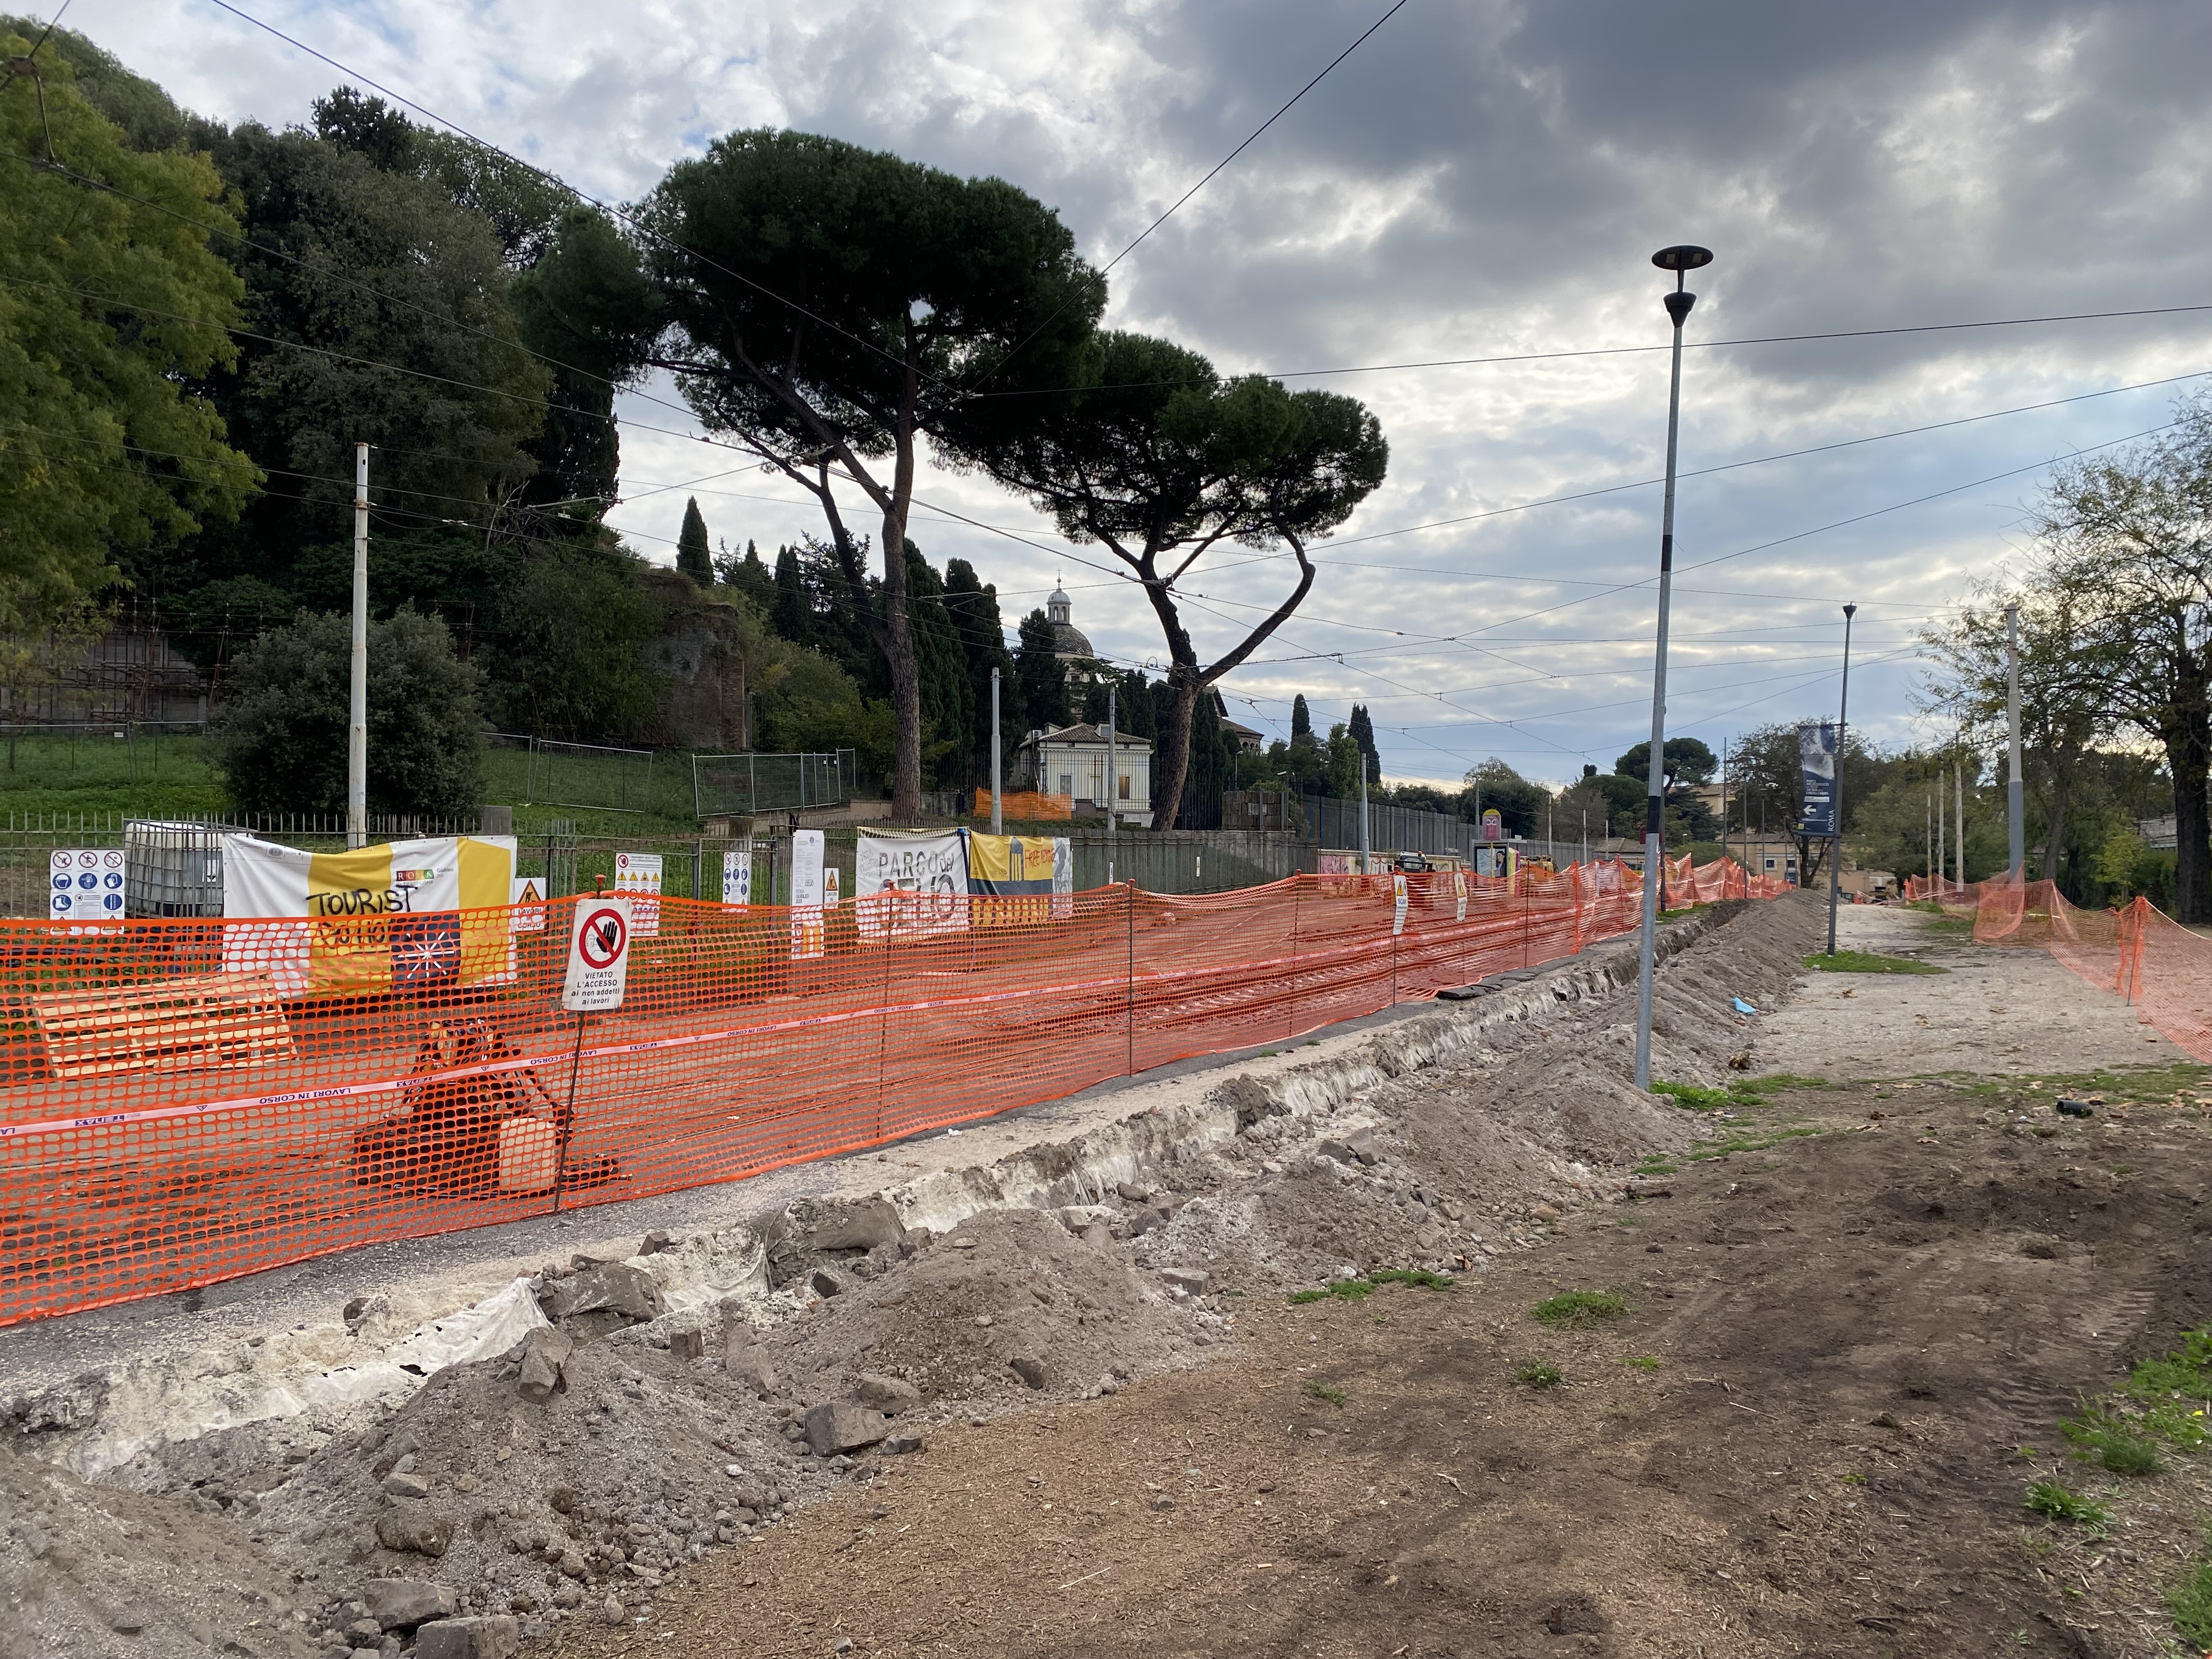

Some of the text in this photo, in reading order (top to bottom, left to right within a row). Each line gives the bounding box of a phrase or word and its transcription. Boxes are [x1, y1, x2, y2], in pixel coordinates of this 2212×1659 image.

[879, 850, 938, 878] PARCO
[939, 853, 954, 872] del
[397, 871, 433, 881] ROMA
[306, 884, 418, 916] TOURIST
[313, 1088, 351, 1098] LAVORI
[259, 1094, 295, 1104] CORSO
[75, 1115, 125, 1127] TENAX
